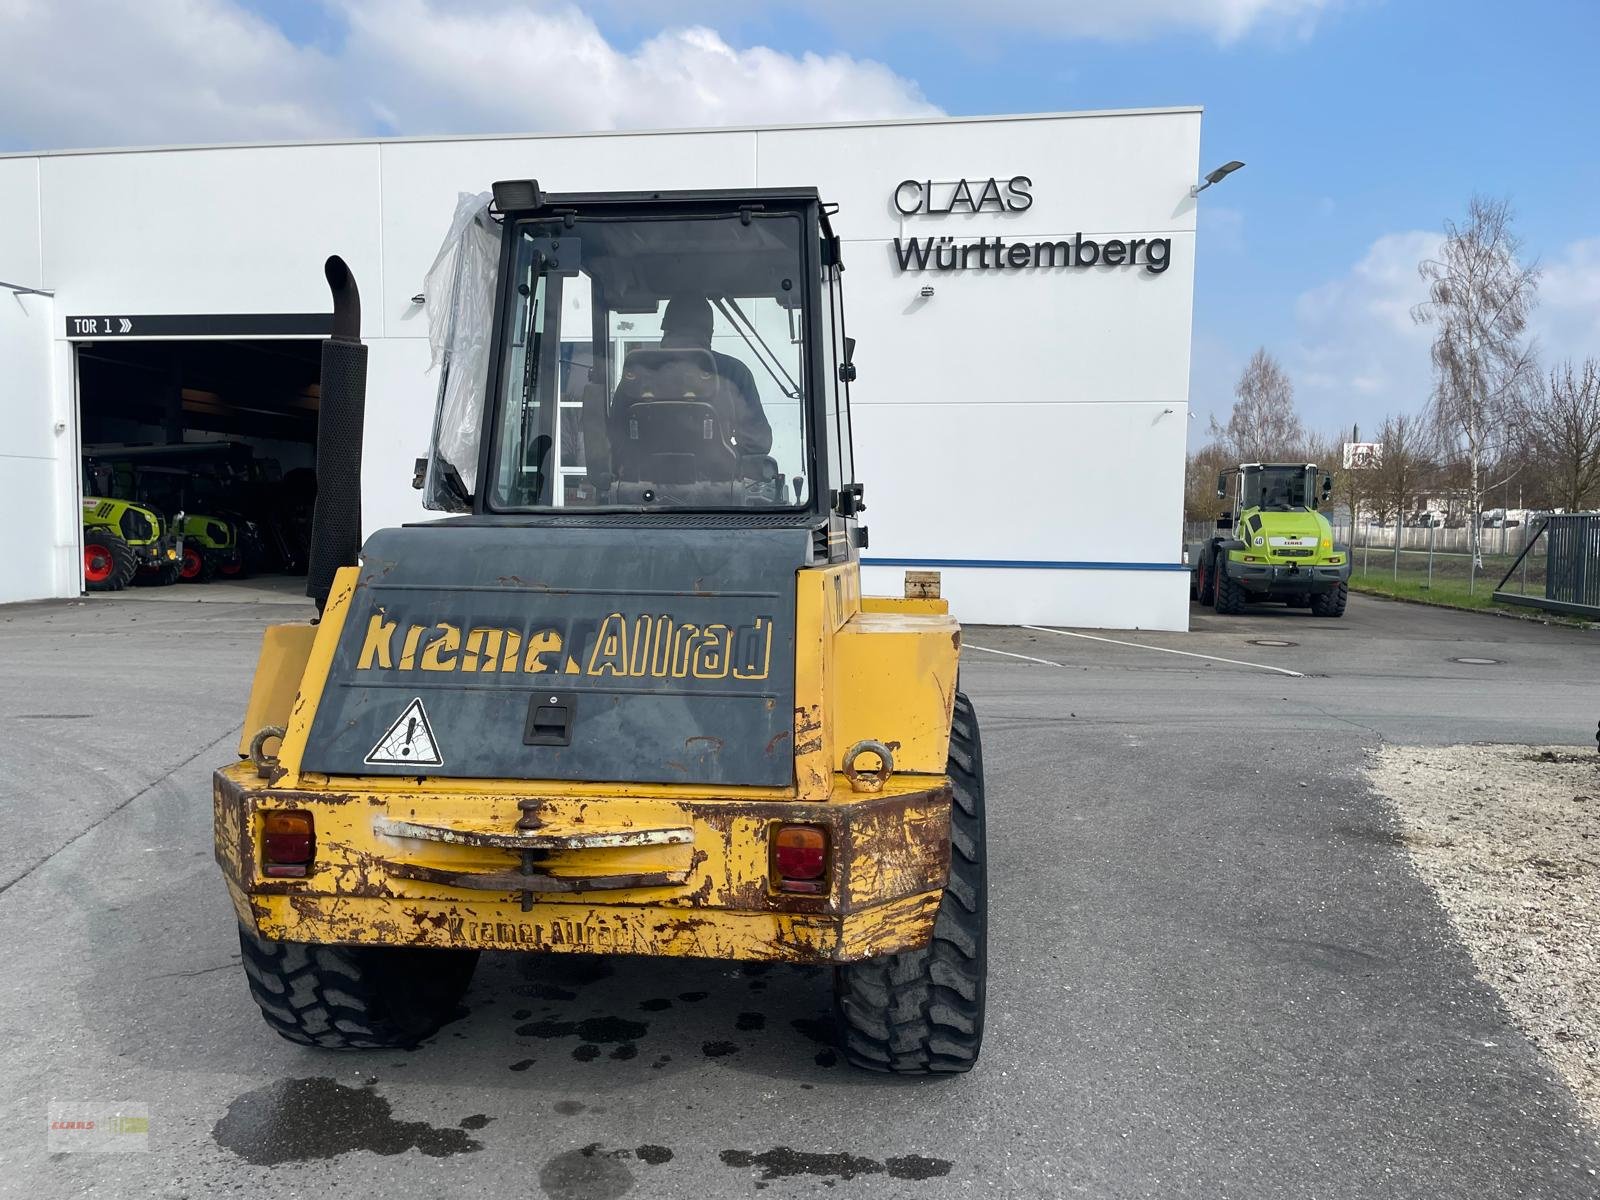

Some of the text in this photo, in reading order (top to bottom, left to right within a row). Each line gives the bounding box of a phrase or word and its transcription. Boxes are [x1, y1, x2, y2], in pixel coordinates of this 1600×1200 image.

[893, 175, 1033, 216] CLAAS
[893, 232, 1172, 274] Württemberg
[74, 318, 113, 334] TOR 1
[586, 612, 774, 680] Allrad
[449, 917, 545, 944] Kramer
